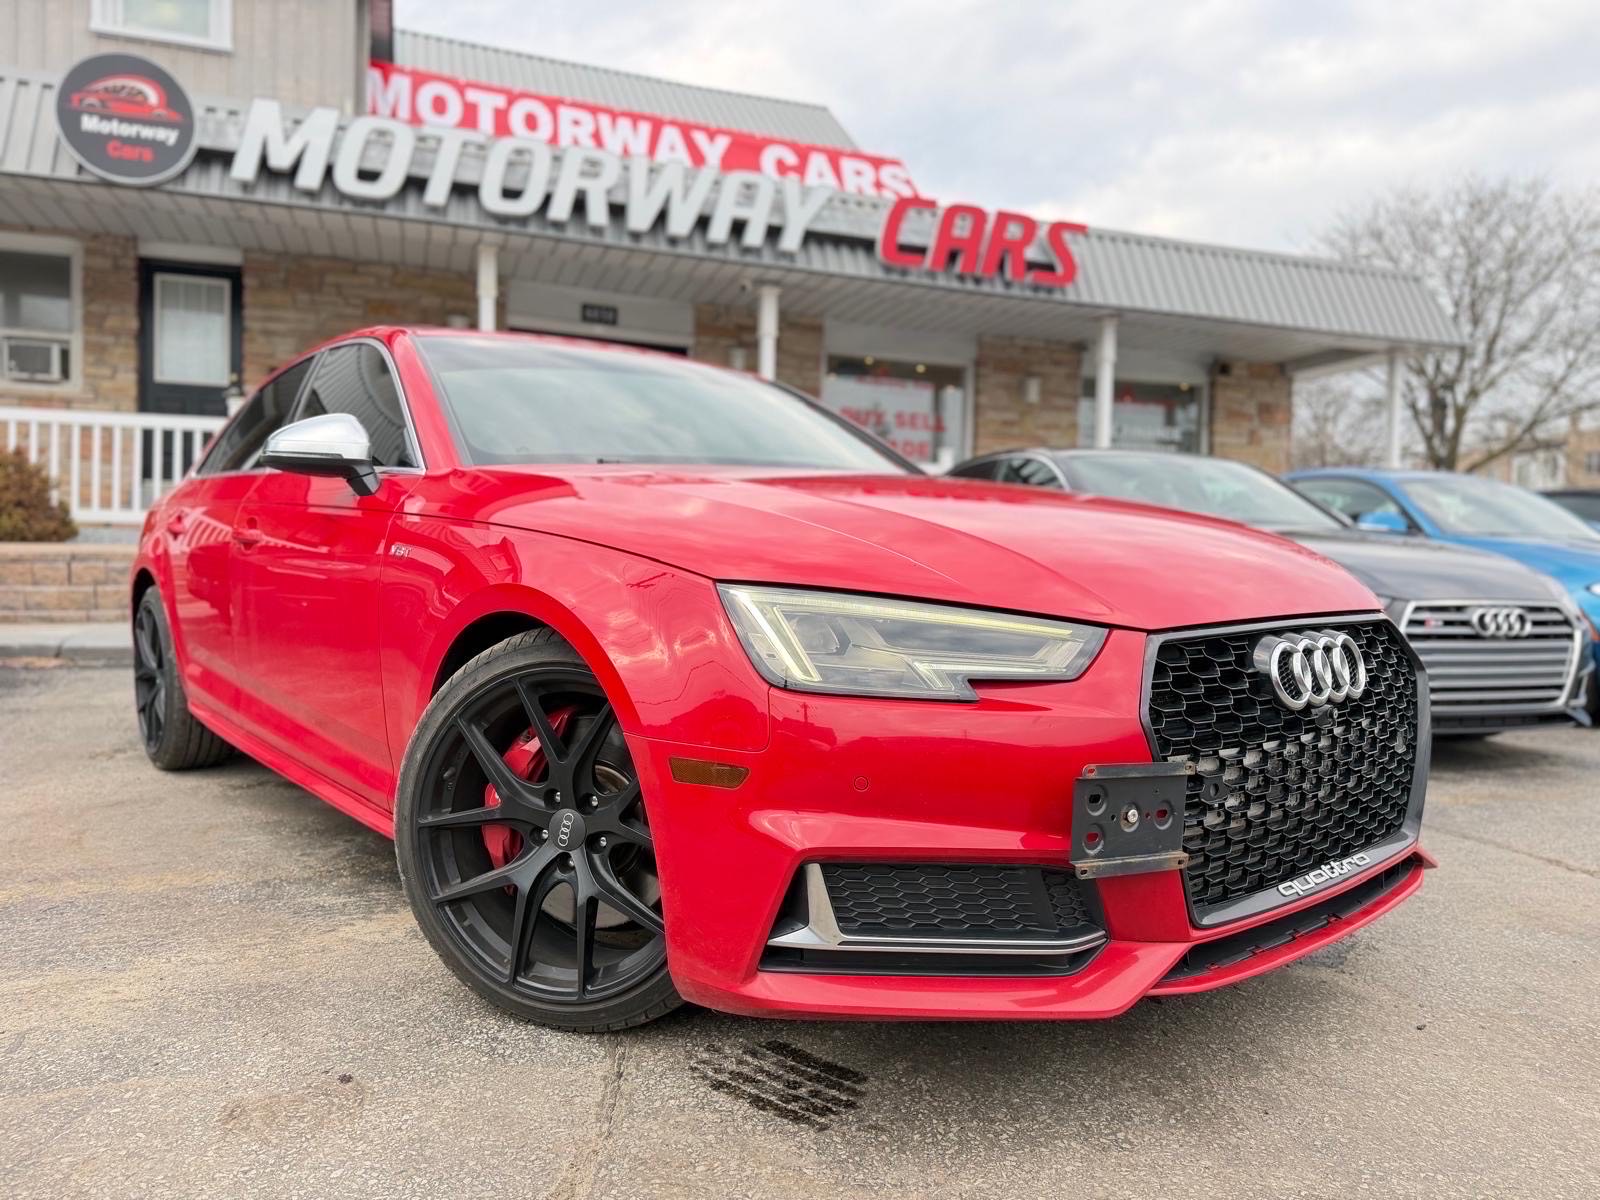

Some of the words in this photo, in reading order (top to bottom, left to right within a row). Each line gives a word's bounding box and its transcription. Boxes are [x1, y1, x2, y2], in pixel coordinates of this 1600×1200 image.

[80, 113, 180, 146] Motorway
[106, 139, 154, 163] Cars
[365, 68, 732, 172] MOTORWAY
[759, 143, 916, 201] CARS
[229, 97, 834, 254] MOTORWAY
[879, 197, 1088, 288] CARS
[1277, 853, 1370, 896] quattro
